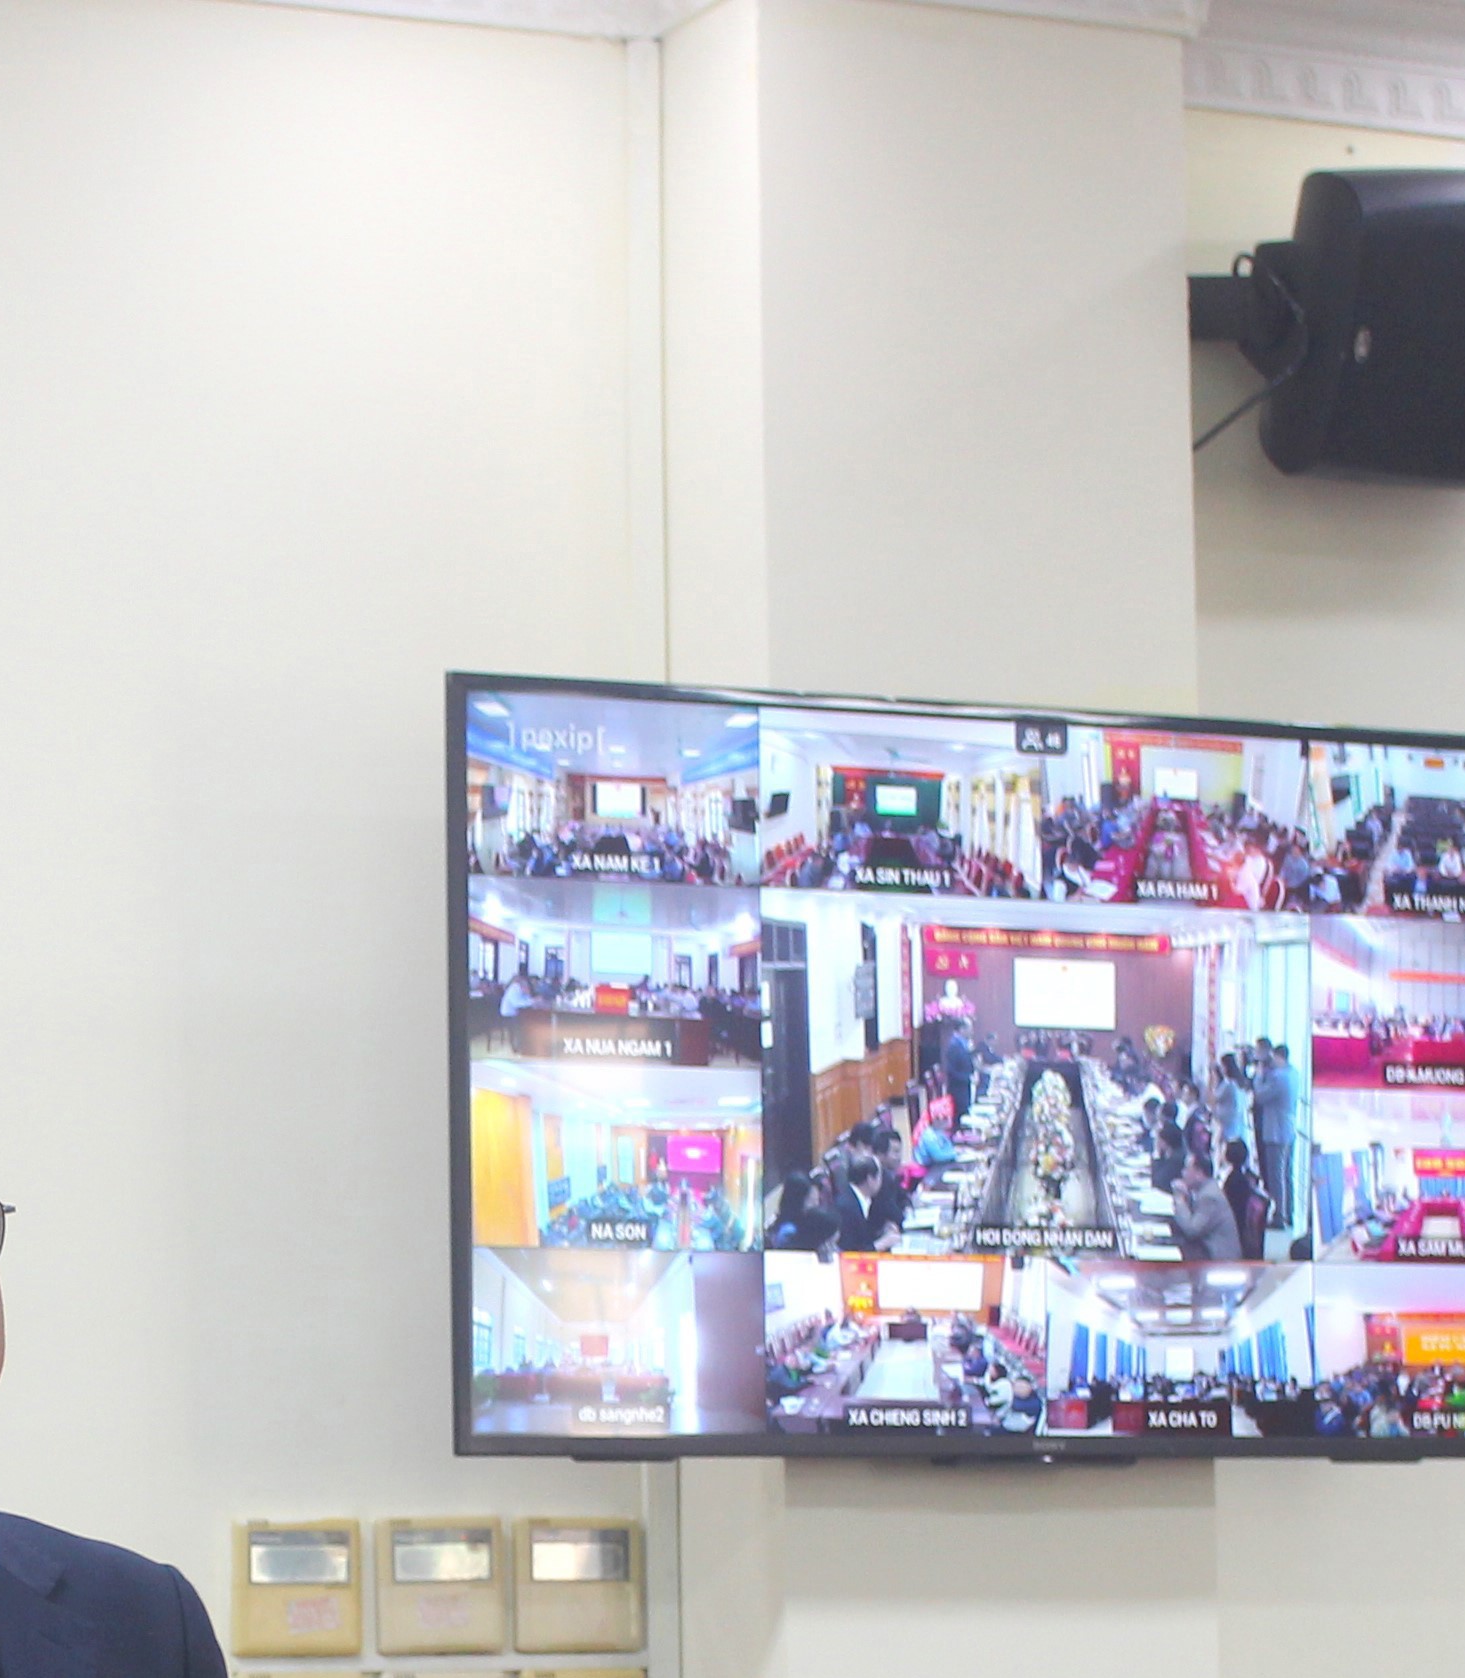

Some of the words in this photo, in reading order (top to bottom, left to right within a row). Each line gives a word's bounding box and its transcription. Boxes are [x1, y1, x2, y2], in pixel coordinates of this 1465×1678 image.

[572, 854, 592, 871] XA
[855, 866, 874, 883] XA
[1136, 880, 1156, 898] XA
[1393, 893, 1412, 911] XA
[563, 1038, 584, 1054] XA
[585, 1038, 616, 1056] NUA
[617, 1039, 661, 1058] NGAM
[591, 1222, 614, 1240] NA
[615, 1222, 647, 1241] SON
[1398, 1239, 1416, 1256] XA
[848, 1408, 868, 1426] XA
[869, 1408, 921, 1427] CHIENG
[922, 1408, 956, 1427] SINH
[957, 1408, 967, 1427] 2
[1148, 1410, 1168, 1428] XA
[1168, 1410, 1197, 1428] CHA
[1199, 1410, 1218, 1428] TO
